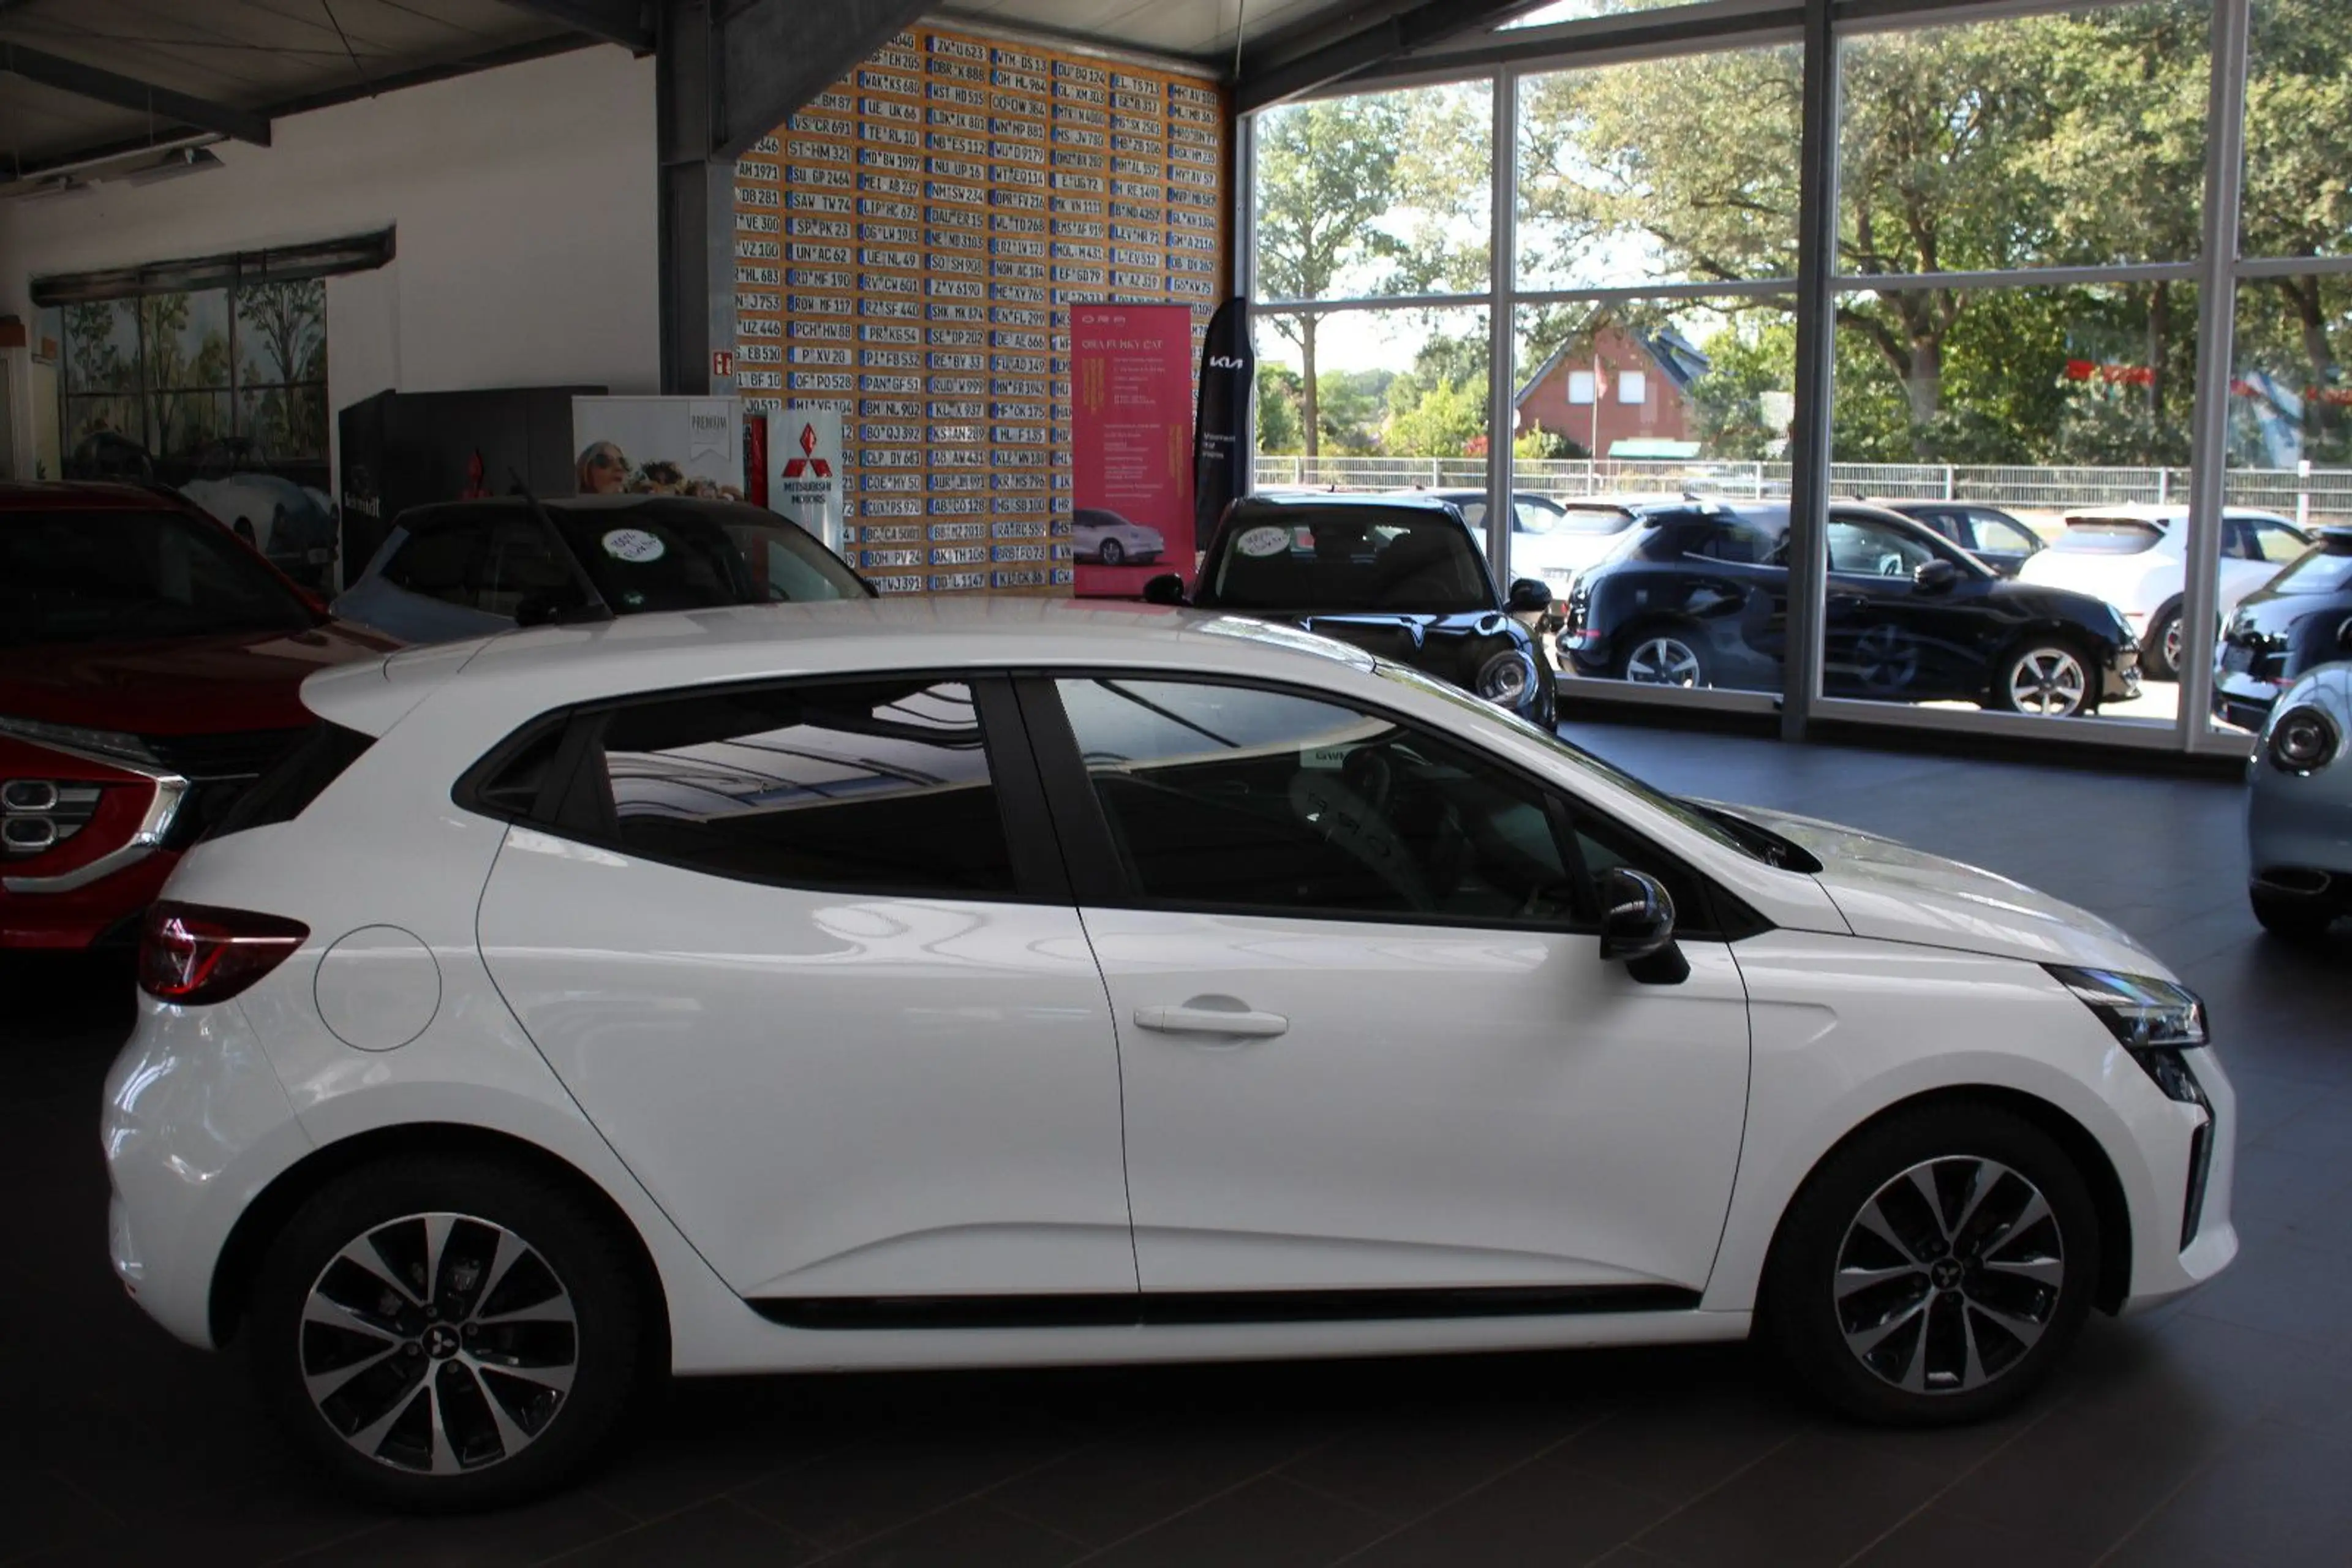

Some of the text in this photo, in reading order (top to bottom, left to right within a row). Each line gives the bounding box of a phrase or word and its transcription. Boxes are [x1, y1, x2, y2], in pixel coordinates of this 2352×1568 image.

[1210, 356, 1243, 369] KIA
[783, 481, 831, 492] MITSUBISHI
[791, 494, 826, 504] MOTORS
